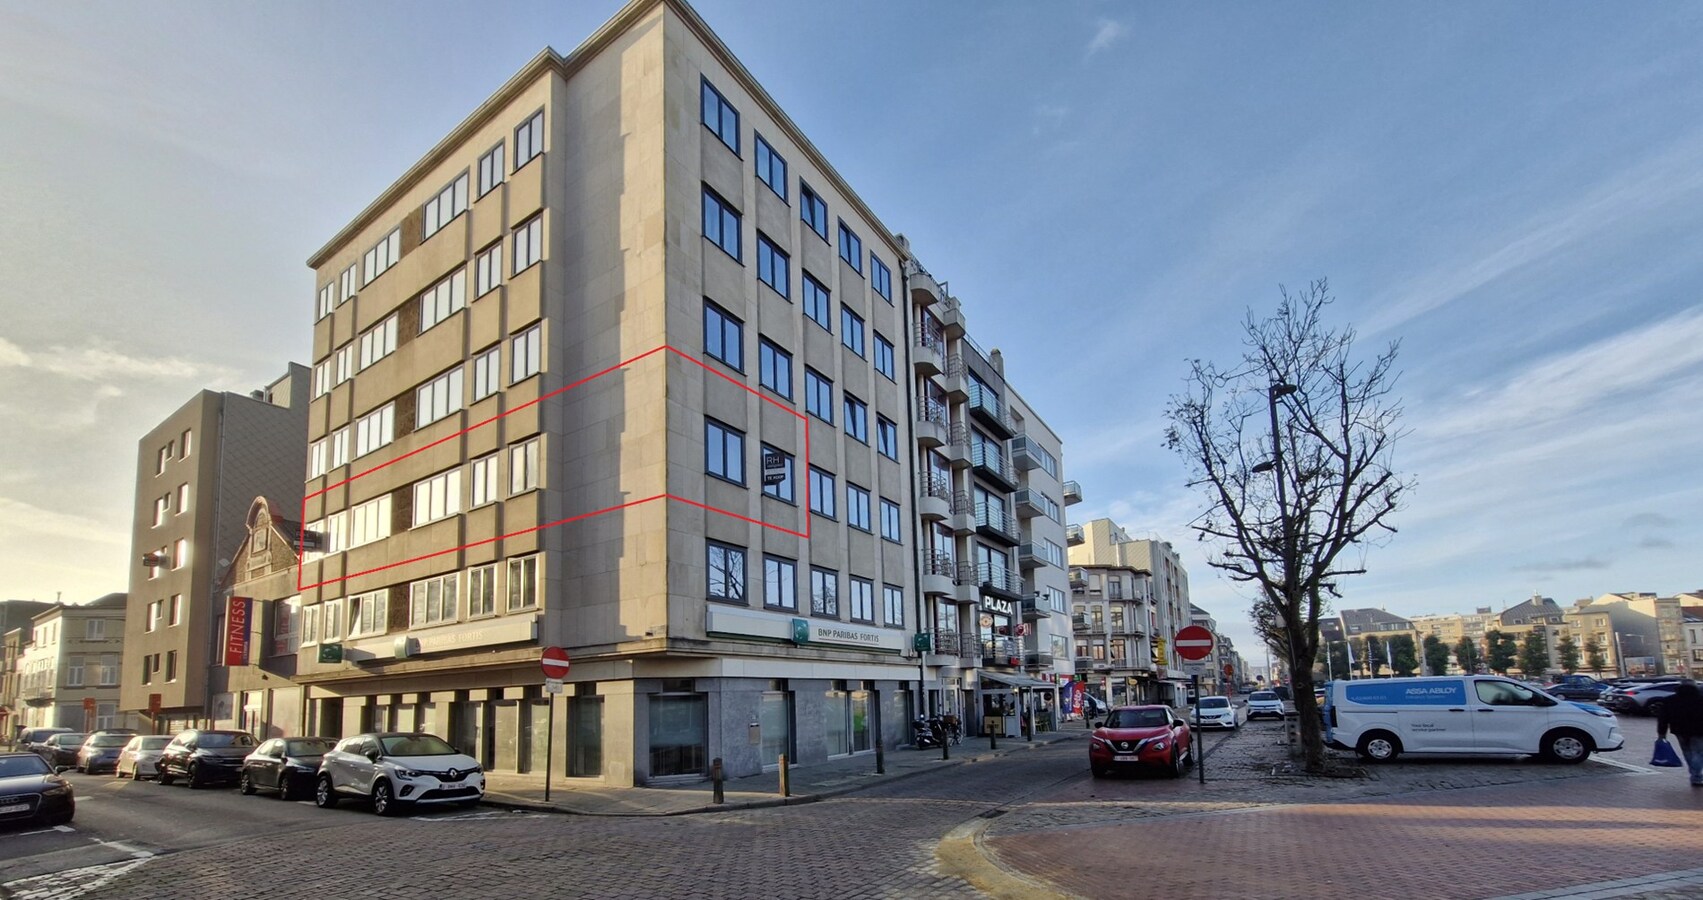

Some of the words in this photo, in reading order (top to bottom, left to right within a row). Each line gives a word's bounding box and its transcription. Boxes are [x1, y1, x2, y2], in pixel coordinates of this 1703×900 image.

[766, 456, 780, 464] RH
[985, 596, 1013, 614] PLAZA
[230, 601, 246, 654] FITNESS
[458, 630, 483, 642] FORTIS
[818, 628, 832, 637] BNP
[833, 629, 858, 640] PARIBAS
[860, 634, 879, 643] FORTIS
